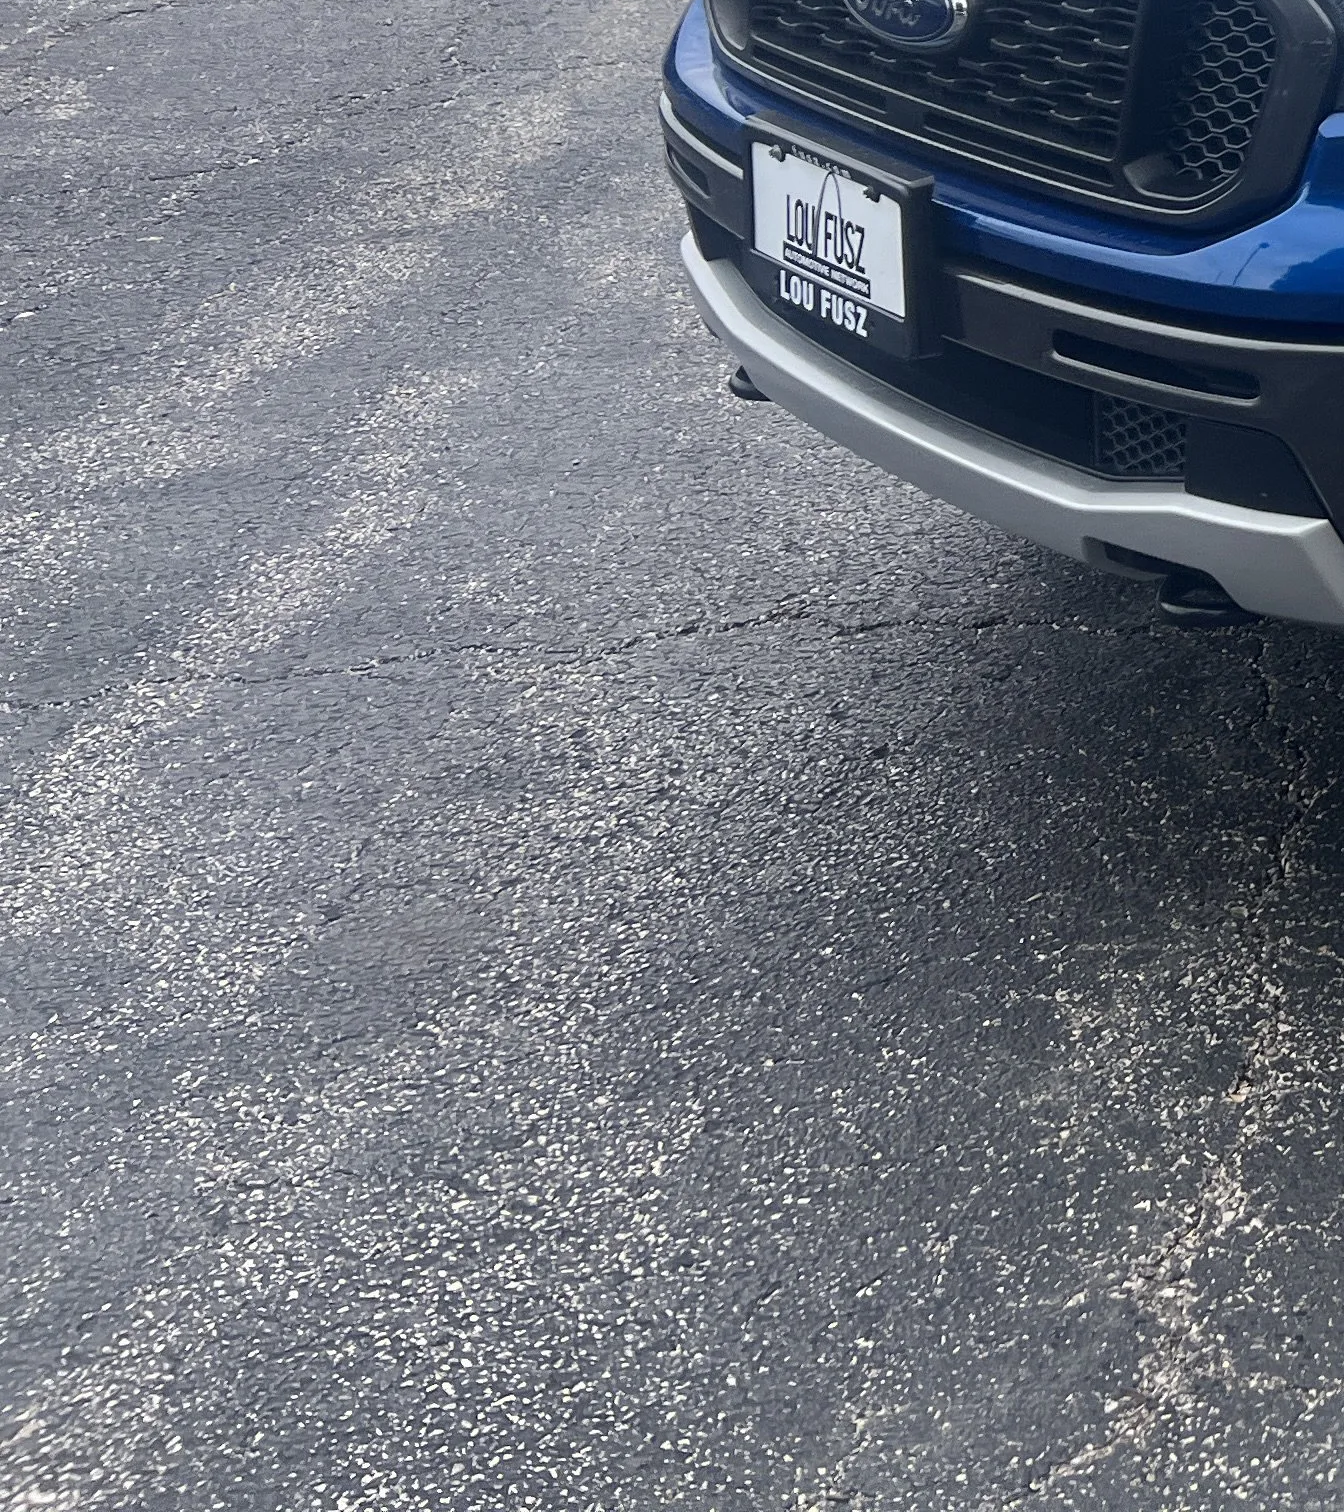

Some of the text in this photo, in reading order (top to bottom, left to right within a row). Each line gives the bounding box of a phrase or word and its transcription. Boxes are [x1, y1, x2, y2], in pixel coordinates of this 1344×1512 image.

[786, 194, 866, 275] LOU FUSZ
[779, 270, 869, 338] LOU FUSZ
